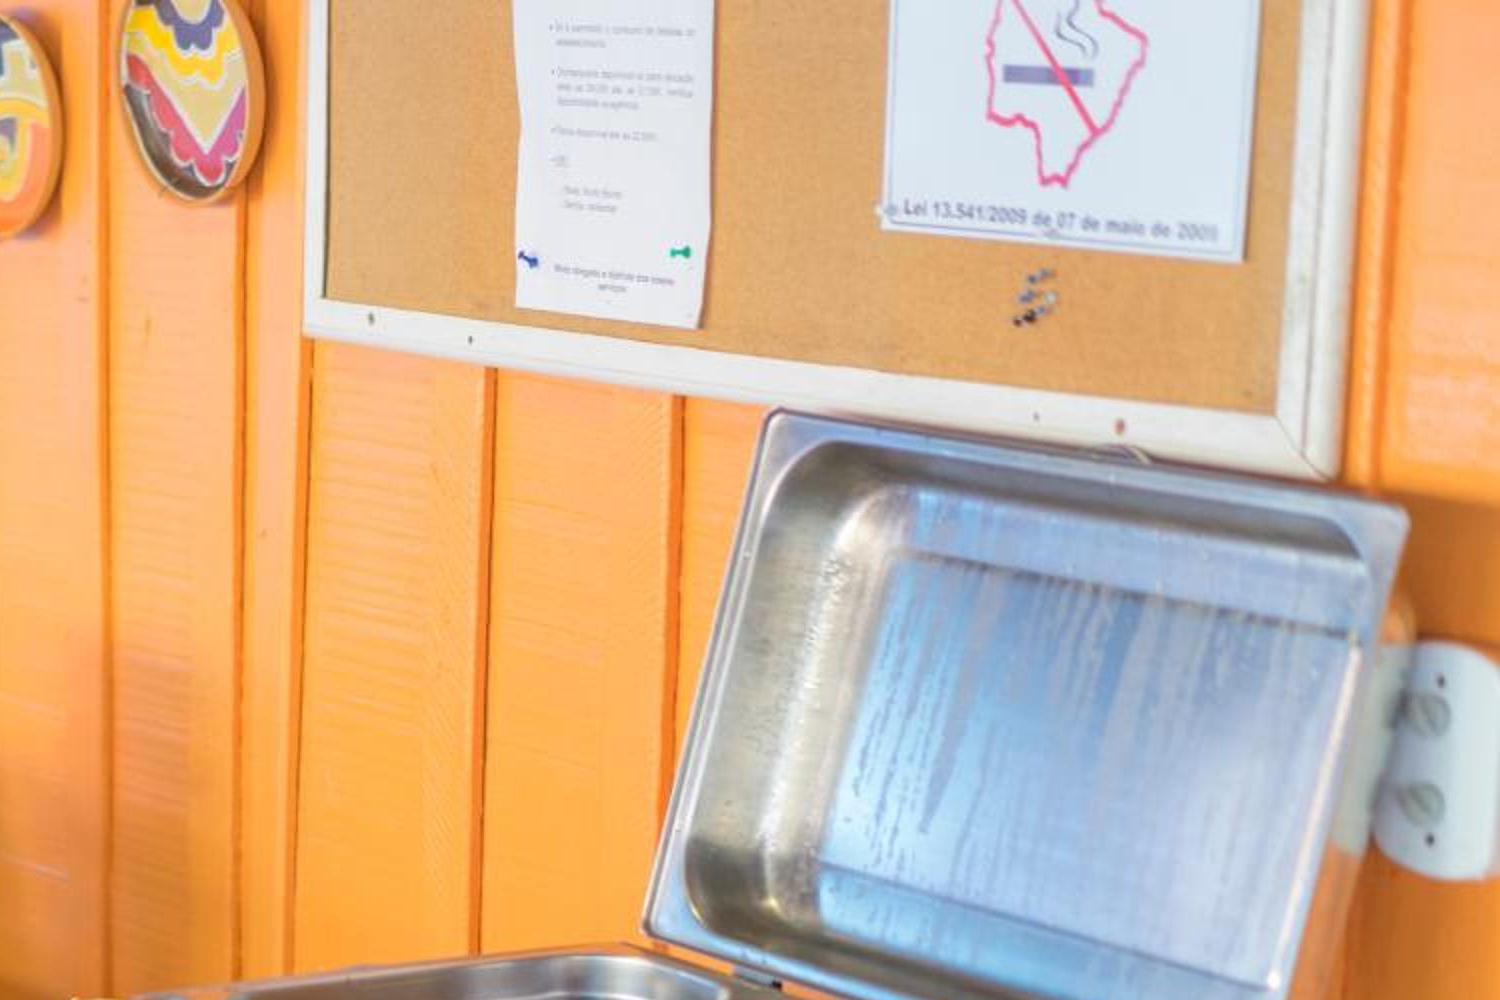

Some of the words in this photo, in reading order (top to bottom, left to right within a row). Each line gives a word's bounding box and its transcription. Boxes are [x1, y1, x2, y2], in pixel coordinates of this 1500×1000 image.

[903, 198, 927, 217] Lei
[1031, 210, 1052, 227] de
[1081, 213, 1101, 231] de
[1150, 218, 1171, 238] de
